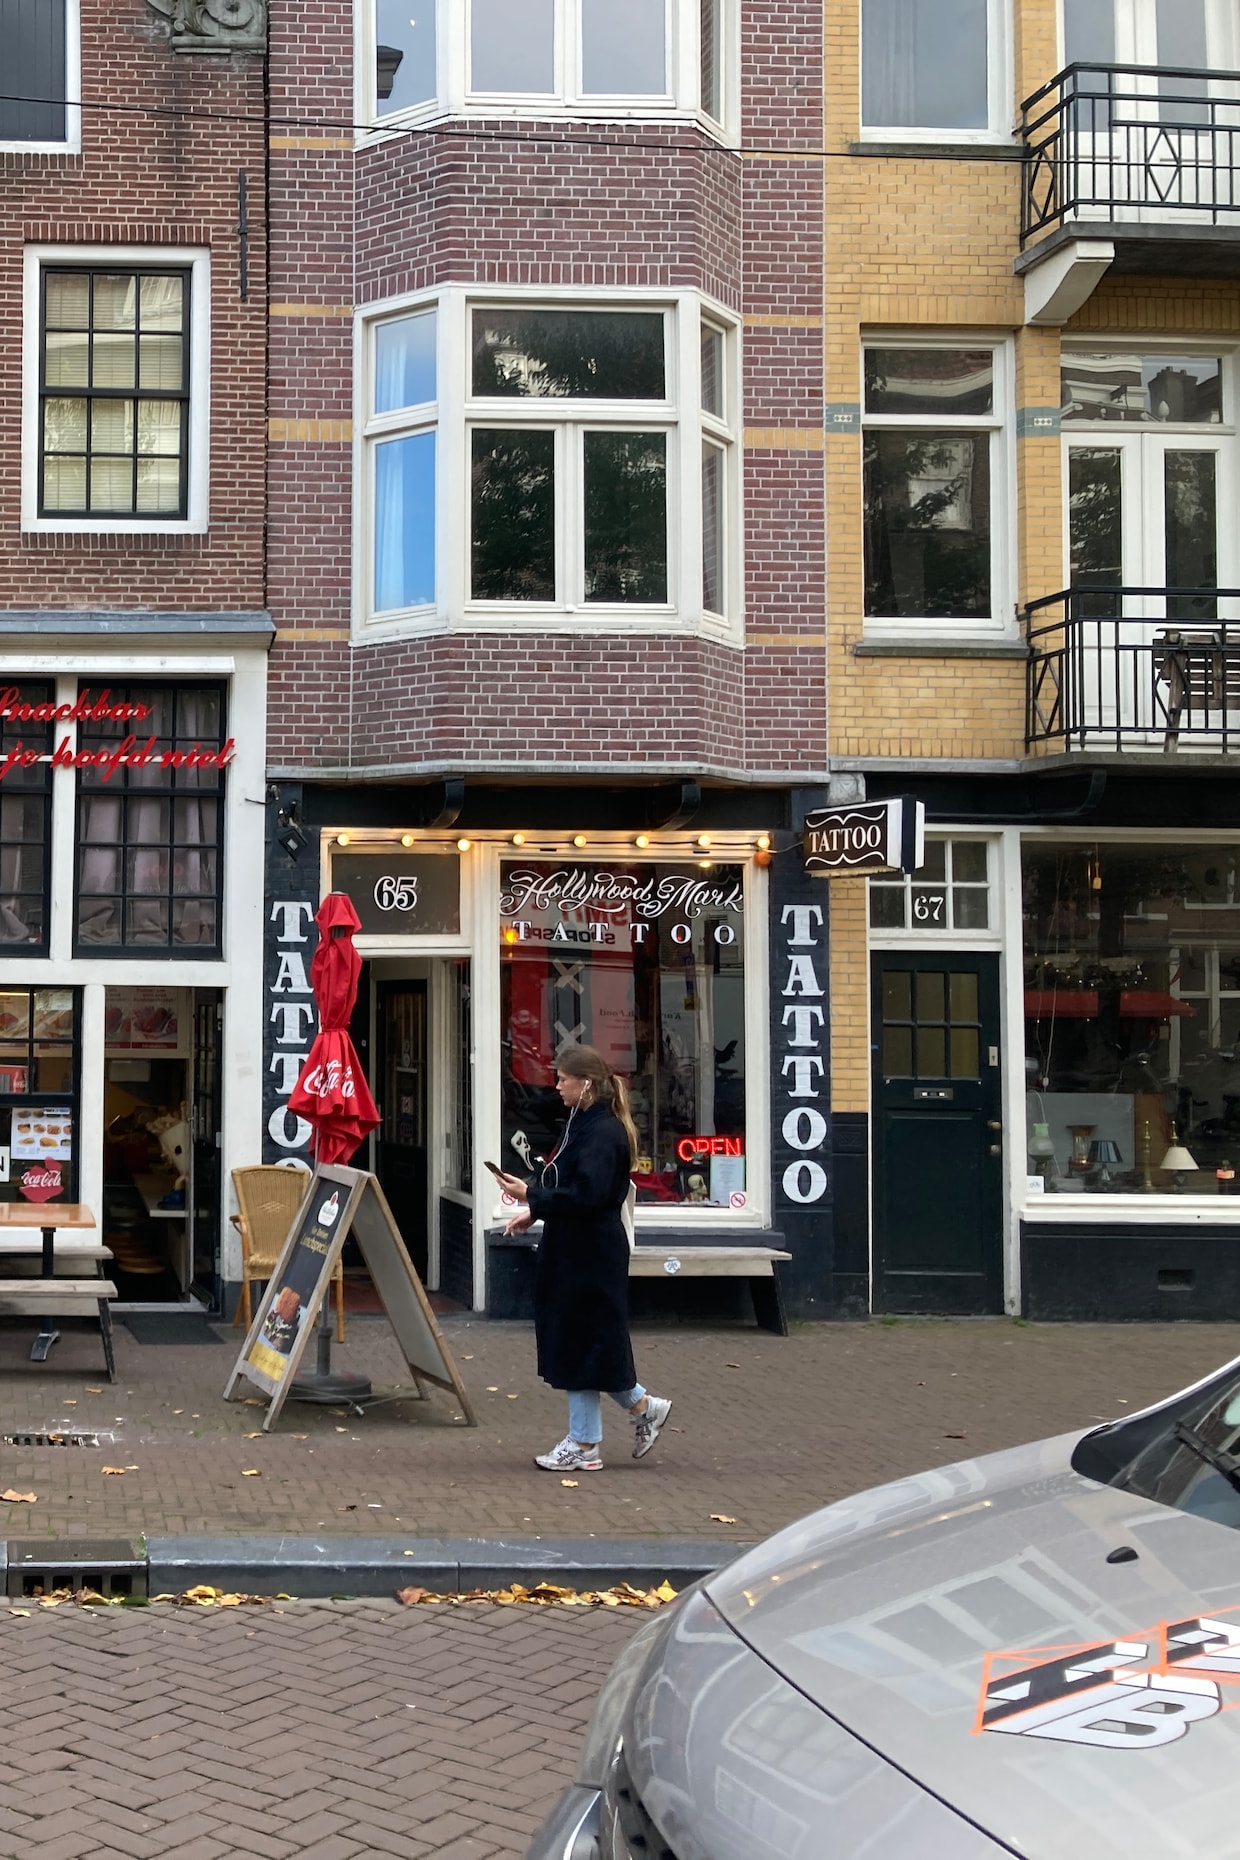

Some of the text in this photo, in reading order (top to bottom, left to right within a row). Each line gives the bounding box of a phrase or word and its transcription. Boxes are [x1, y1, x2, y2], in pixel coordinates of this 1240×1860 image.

[50, 735, 160, 784] hoofd
[160, 737, 237, 770] niet
[808, 824, 882, 853] TATTOO
[374, 876, 418, 912] 65
[500, 868, 746, 918] Hollywood Mark
[913, 896, 944, 921] 67
[512, 920, 735, 945] TATTOO
[268, 901, 314, 1178] TATTO
[780, 904, 827, 1204] TATTOO
[678, 1137, 742, 1162] OPEN
